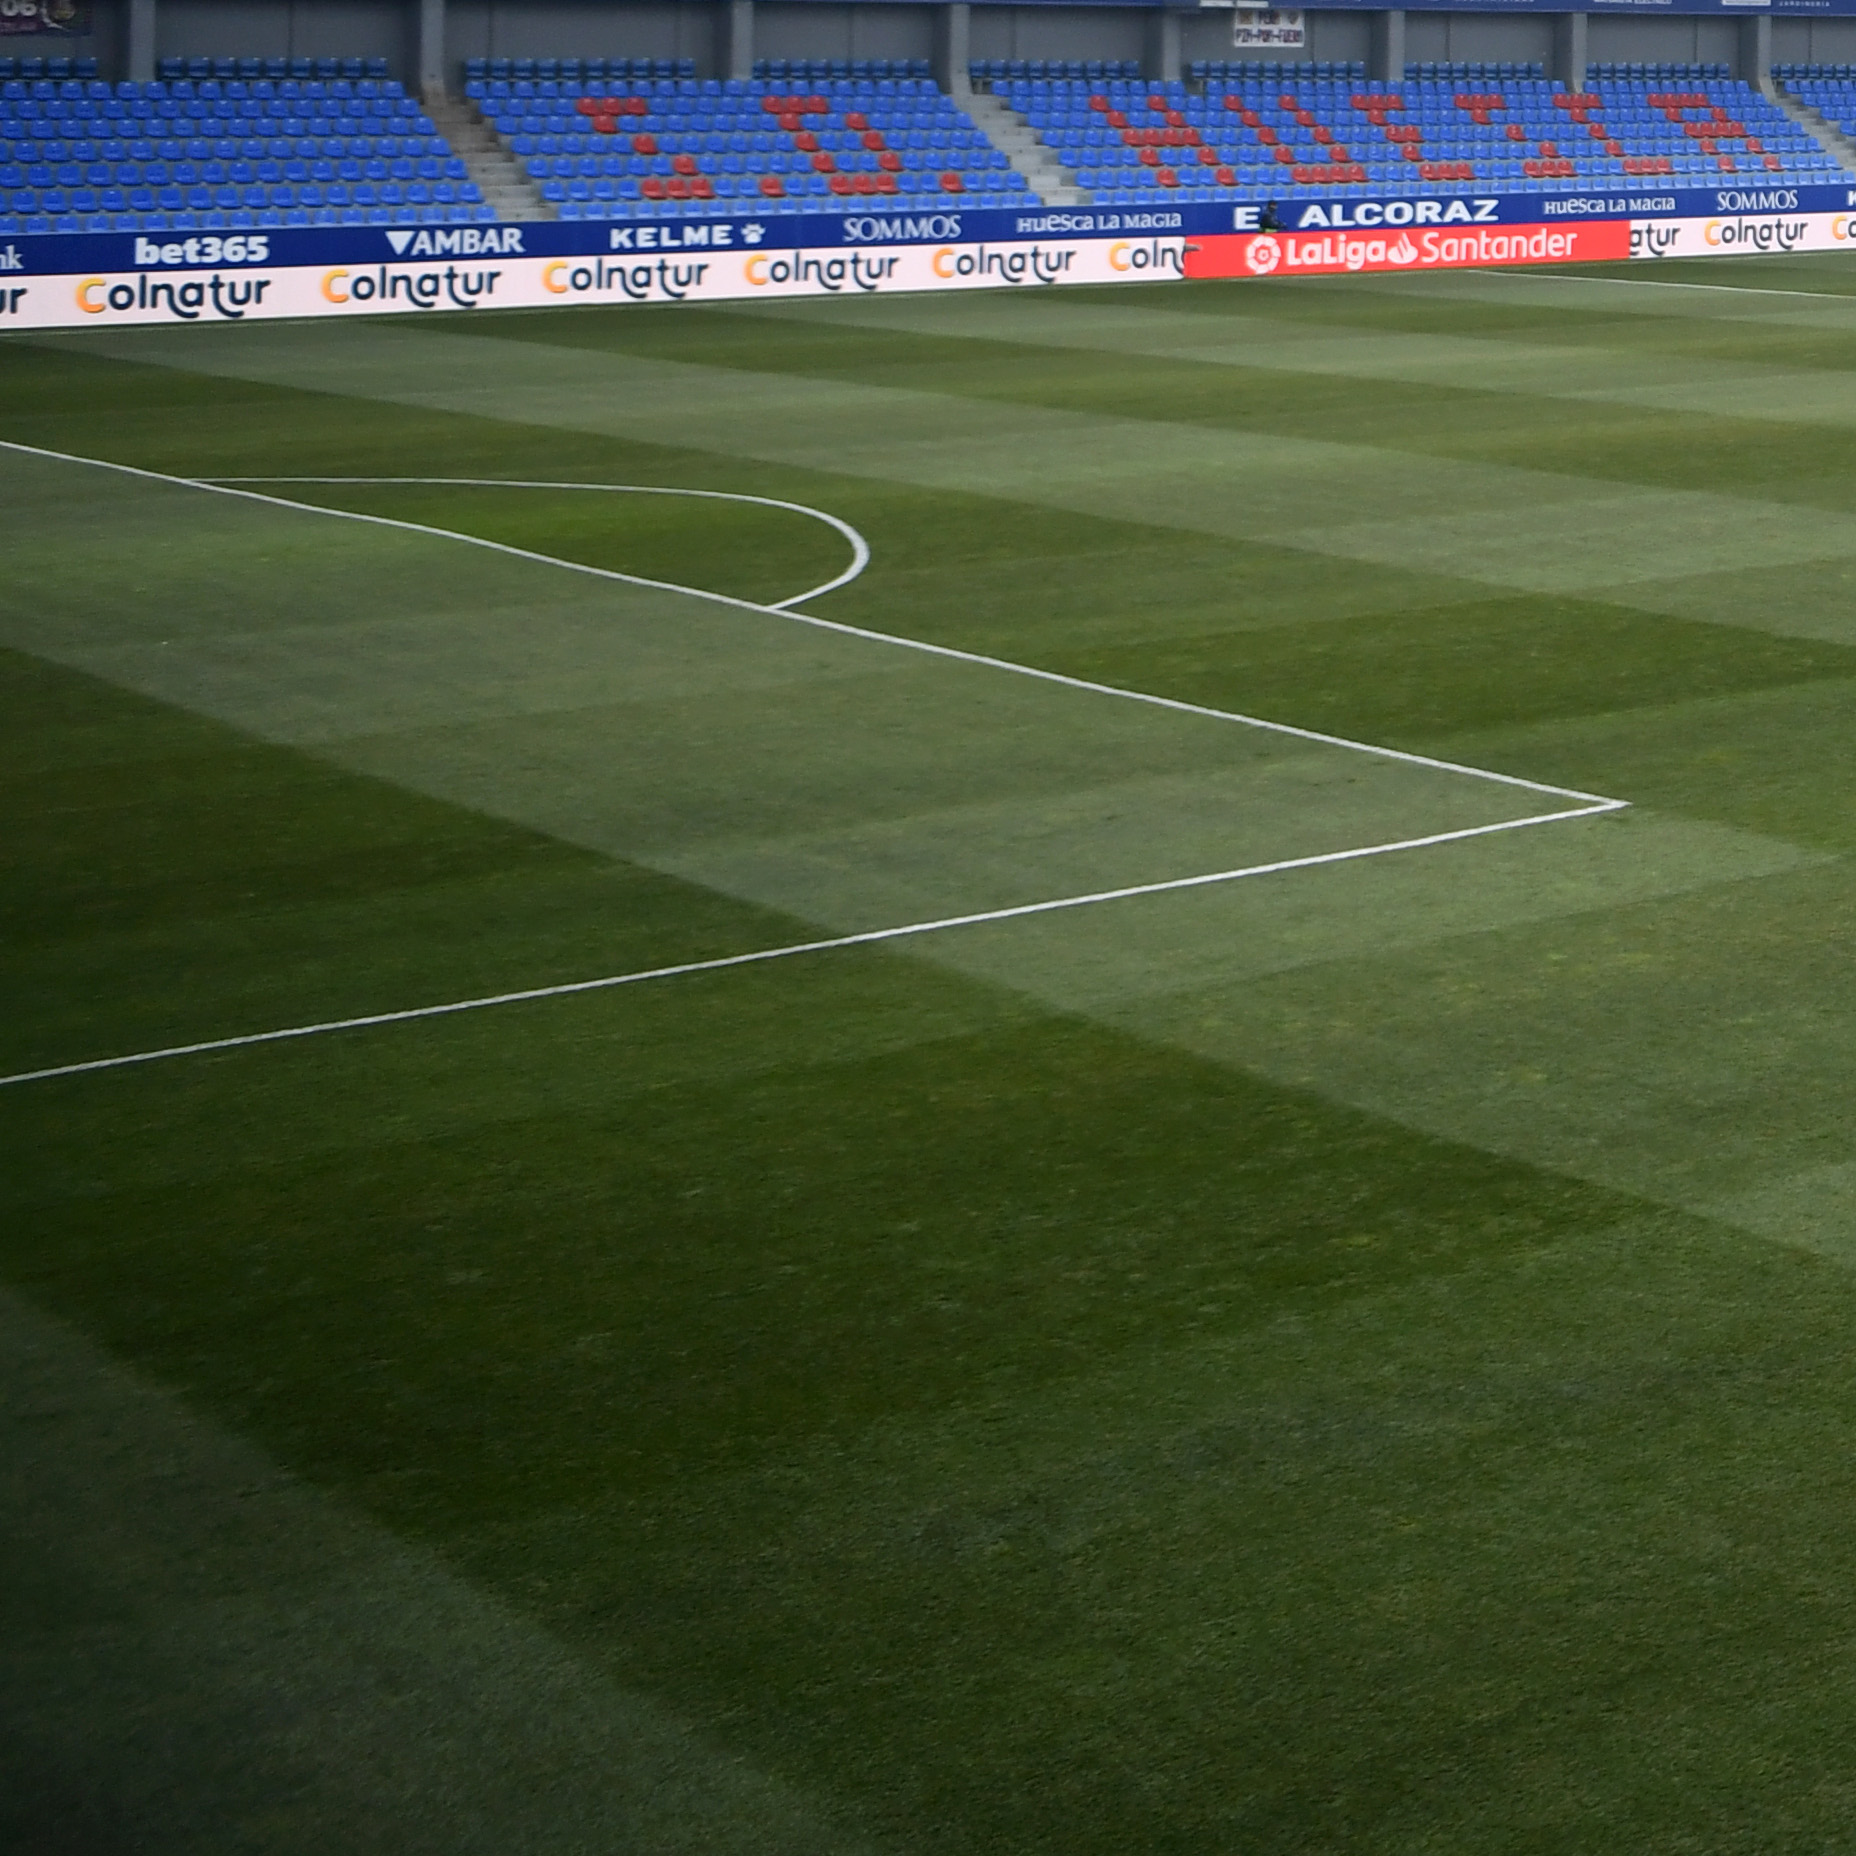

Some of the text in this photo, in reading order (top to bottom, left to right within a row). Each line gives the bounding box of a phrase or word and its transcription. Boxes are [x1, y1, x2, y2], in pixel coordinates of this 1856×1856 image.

[1300, 200, 1499, 227] ALCORAZ
[1717, 189, 1798, 211] SOMMOS
[411, 228, 526, 256] AMBAR
[610, 224, 733, 249] KELME
[843, 215, 962, 242] SOMMOS
[1704, 217, 1808, 250] Colnatur
[135, 236, 270, 265] bet365
[933, 244, 1076, 283] Colnatur
[1286, 228, 1578, 271] LaLiga Santander
[322, 265, 501, 308] Colnatur
[542, 257, 709, 299] Colnatur
[744, 250, 899, 290] Colnatur
[76, 273, 271, 319] Colnatur
